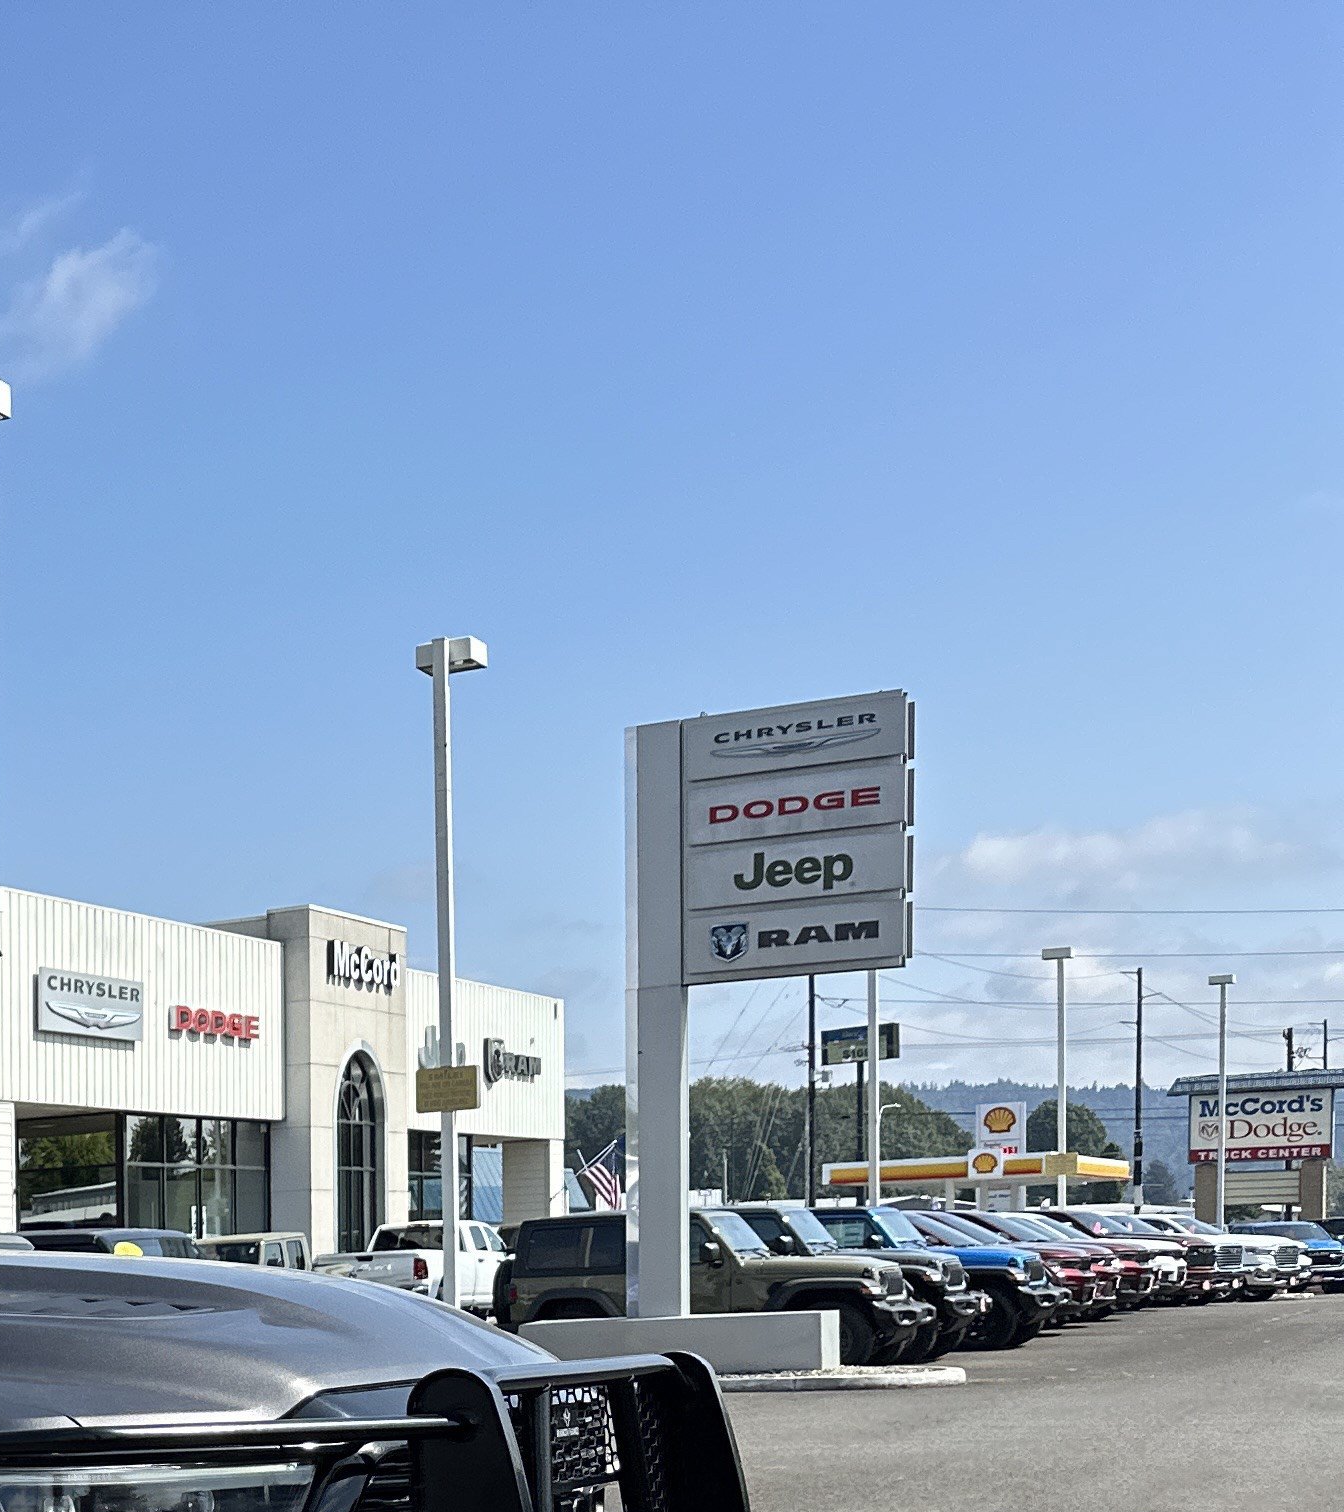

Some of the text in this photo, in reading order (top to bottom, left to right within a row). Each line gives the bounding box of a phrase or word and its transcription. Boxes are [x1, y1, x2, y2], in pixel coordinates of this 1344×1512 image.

[714, 713, 877, 744] CHRYSLER
[708, 786, 881, 825] DODGE
[733, 852, 853, 891] Jeep
[757, 920, 880, 949] RAM
[330, 939, 400, 988] McCord
[47, 975, 140, 1003] CHRYSLER
[171, 1005, 260, 1039] DODGE
[502, 1052, 542, 1076] RAM
[1199, 1095, 1323, 1118] McCord's
[1257, 1146, 1322, 1158] CENTER
